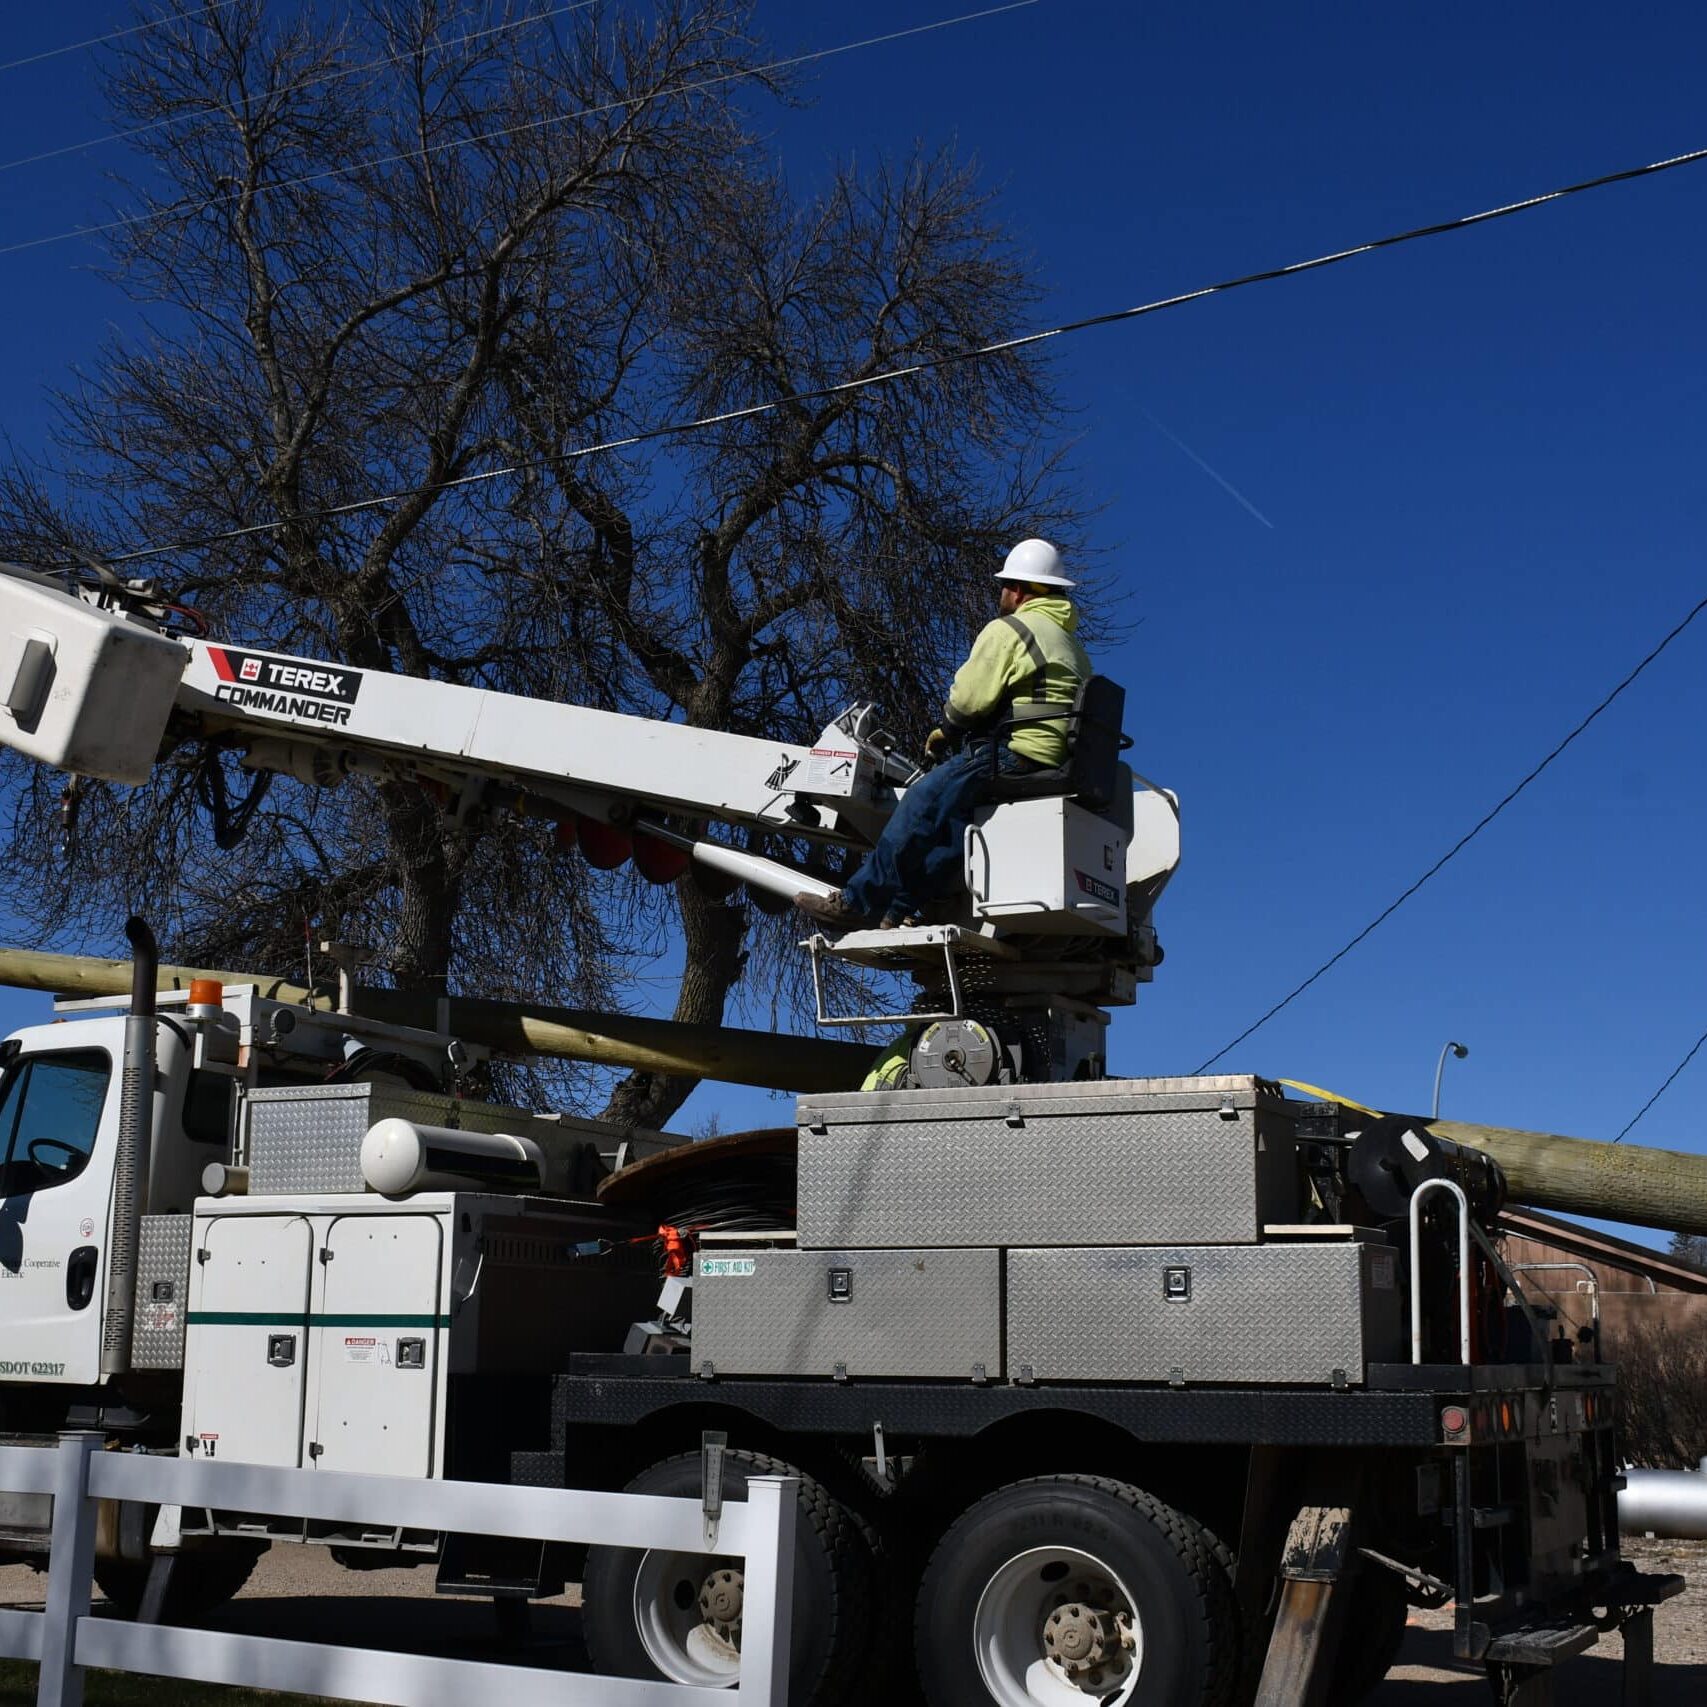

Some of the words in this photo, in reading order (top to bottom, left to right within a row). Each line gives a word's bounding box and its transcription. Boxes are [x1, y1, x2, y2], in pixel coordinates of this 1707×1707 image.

[268, 664, 344, 695] TEREX
[214, 684, 352, 726] COMMANDER
[24, 1258, 61, 1270] Cooperative
[714, 1261, 730, 1273] FIRST
[732, 1261, 742, 1273] AID
